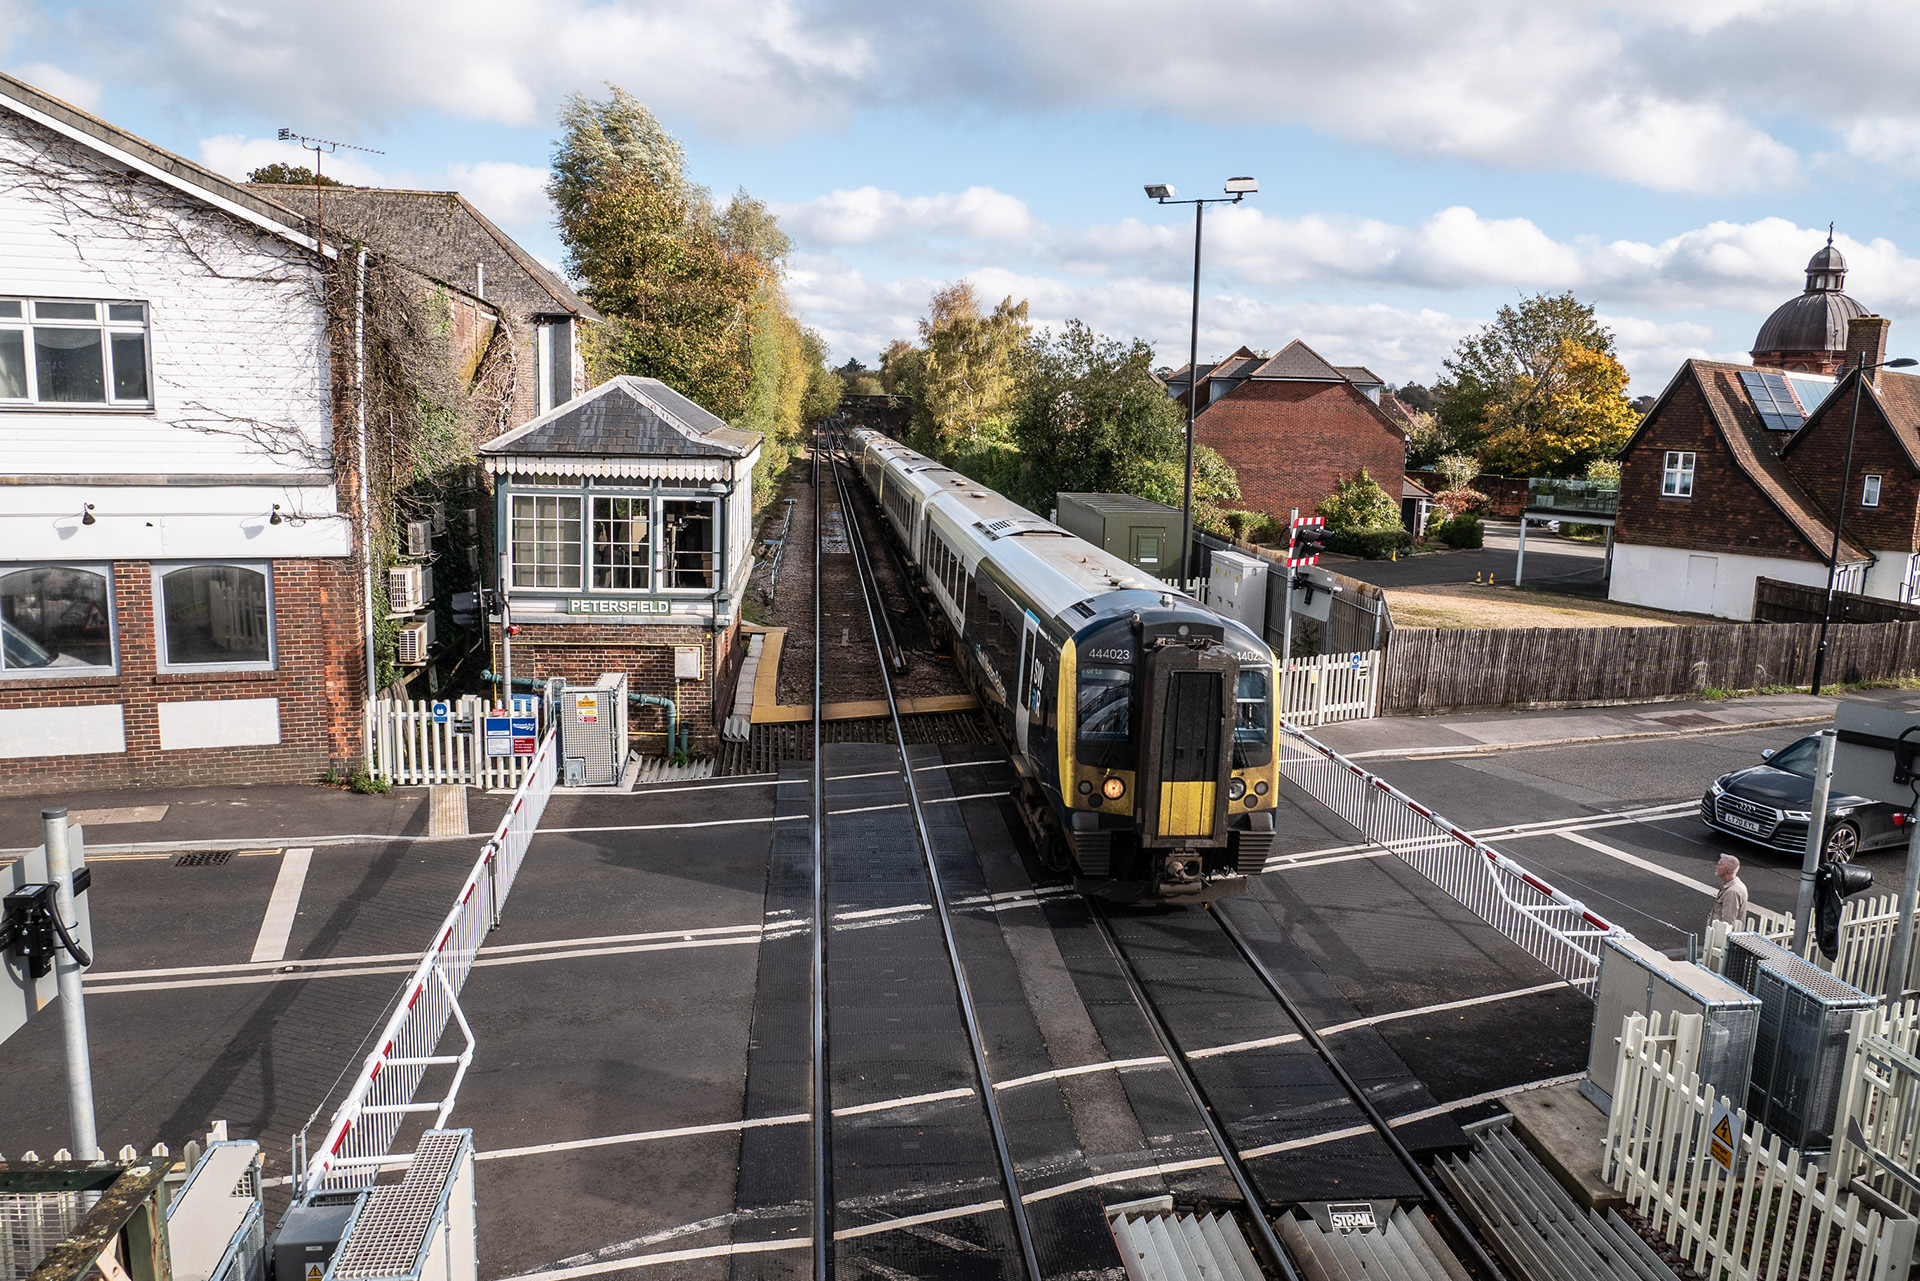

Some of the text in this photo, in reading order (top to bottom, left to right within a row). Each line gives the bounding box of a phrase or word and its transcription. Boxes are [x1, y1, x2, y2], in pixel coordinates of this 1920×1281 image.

[571, 600, 668, 613] PETERSFIELD
[1089, 648, 1130, 660] 444023
[1743, 820, 1756, 830] EYL
[1333, 1213, 1376, 1227] STRAIL
